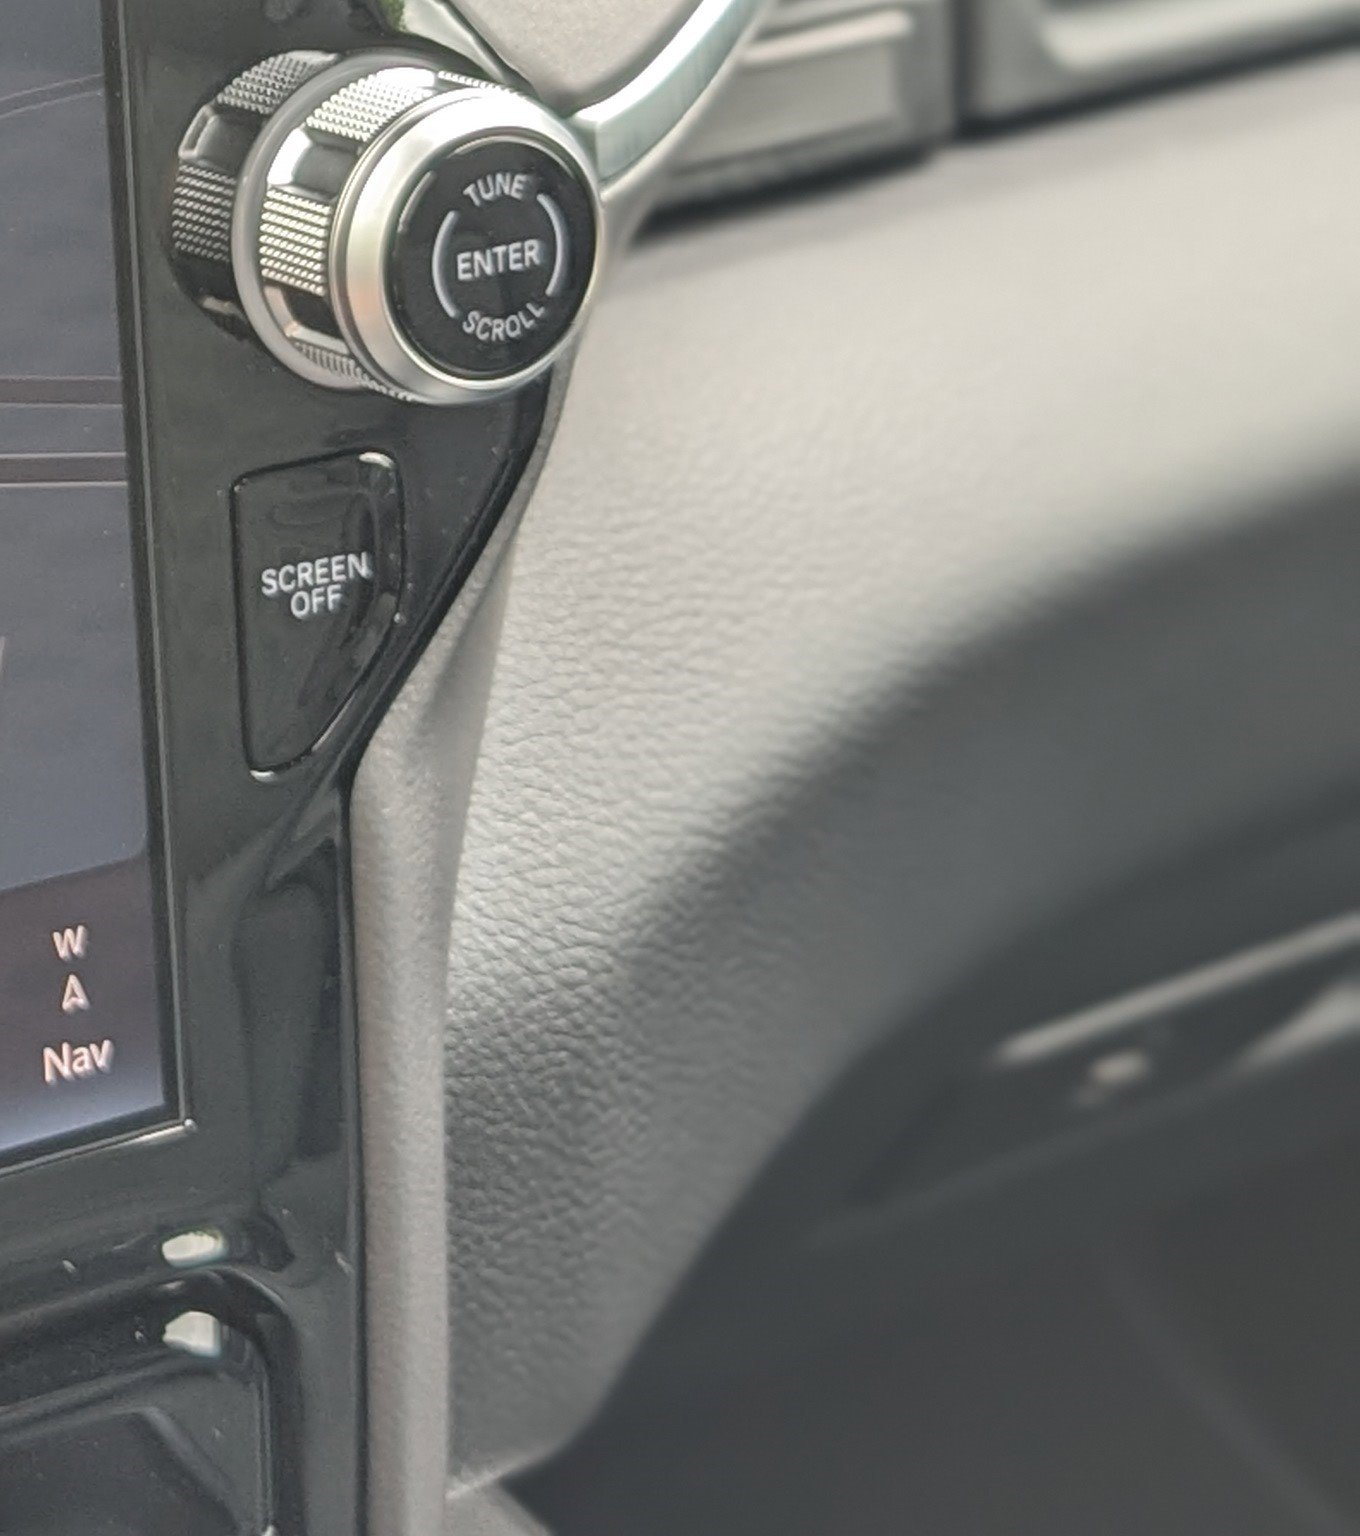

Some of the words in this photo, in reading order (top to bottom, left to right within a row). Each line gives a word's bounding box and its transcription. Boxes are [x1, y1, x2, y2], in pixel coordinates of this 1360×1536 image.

[463, 173, 527, 206] TUNE
[457, 239, 540, 281] ENTER
[462, 302, 545, 342] SCROLL
[261, 551, 371, 597] SCREEN
[289, 585, 342, 620] OFF
[53, 925, 84, 958] W
[43, 1039, 111, 1082] Nav
